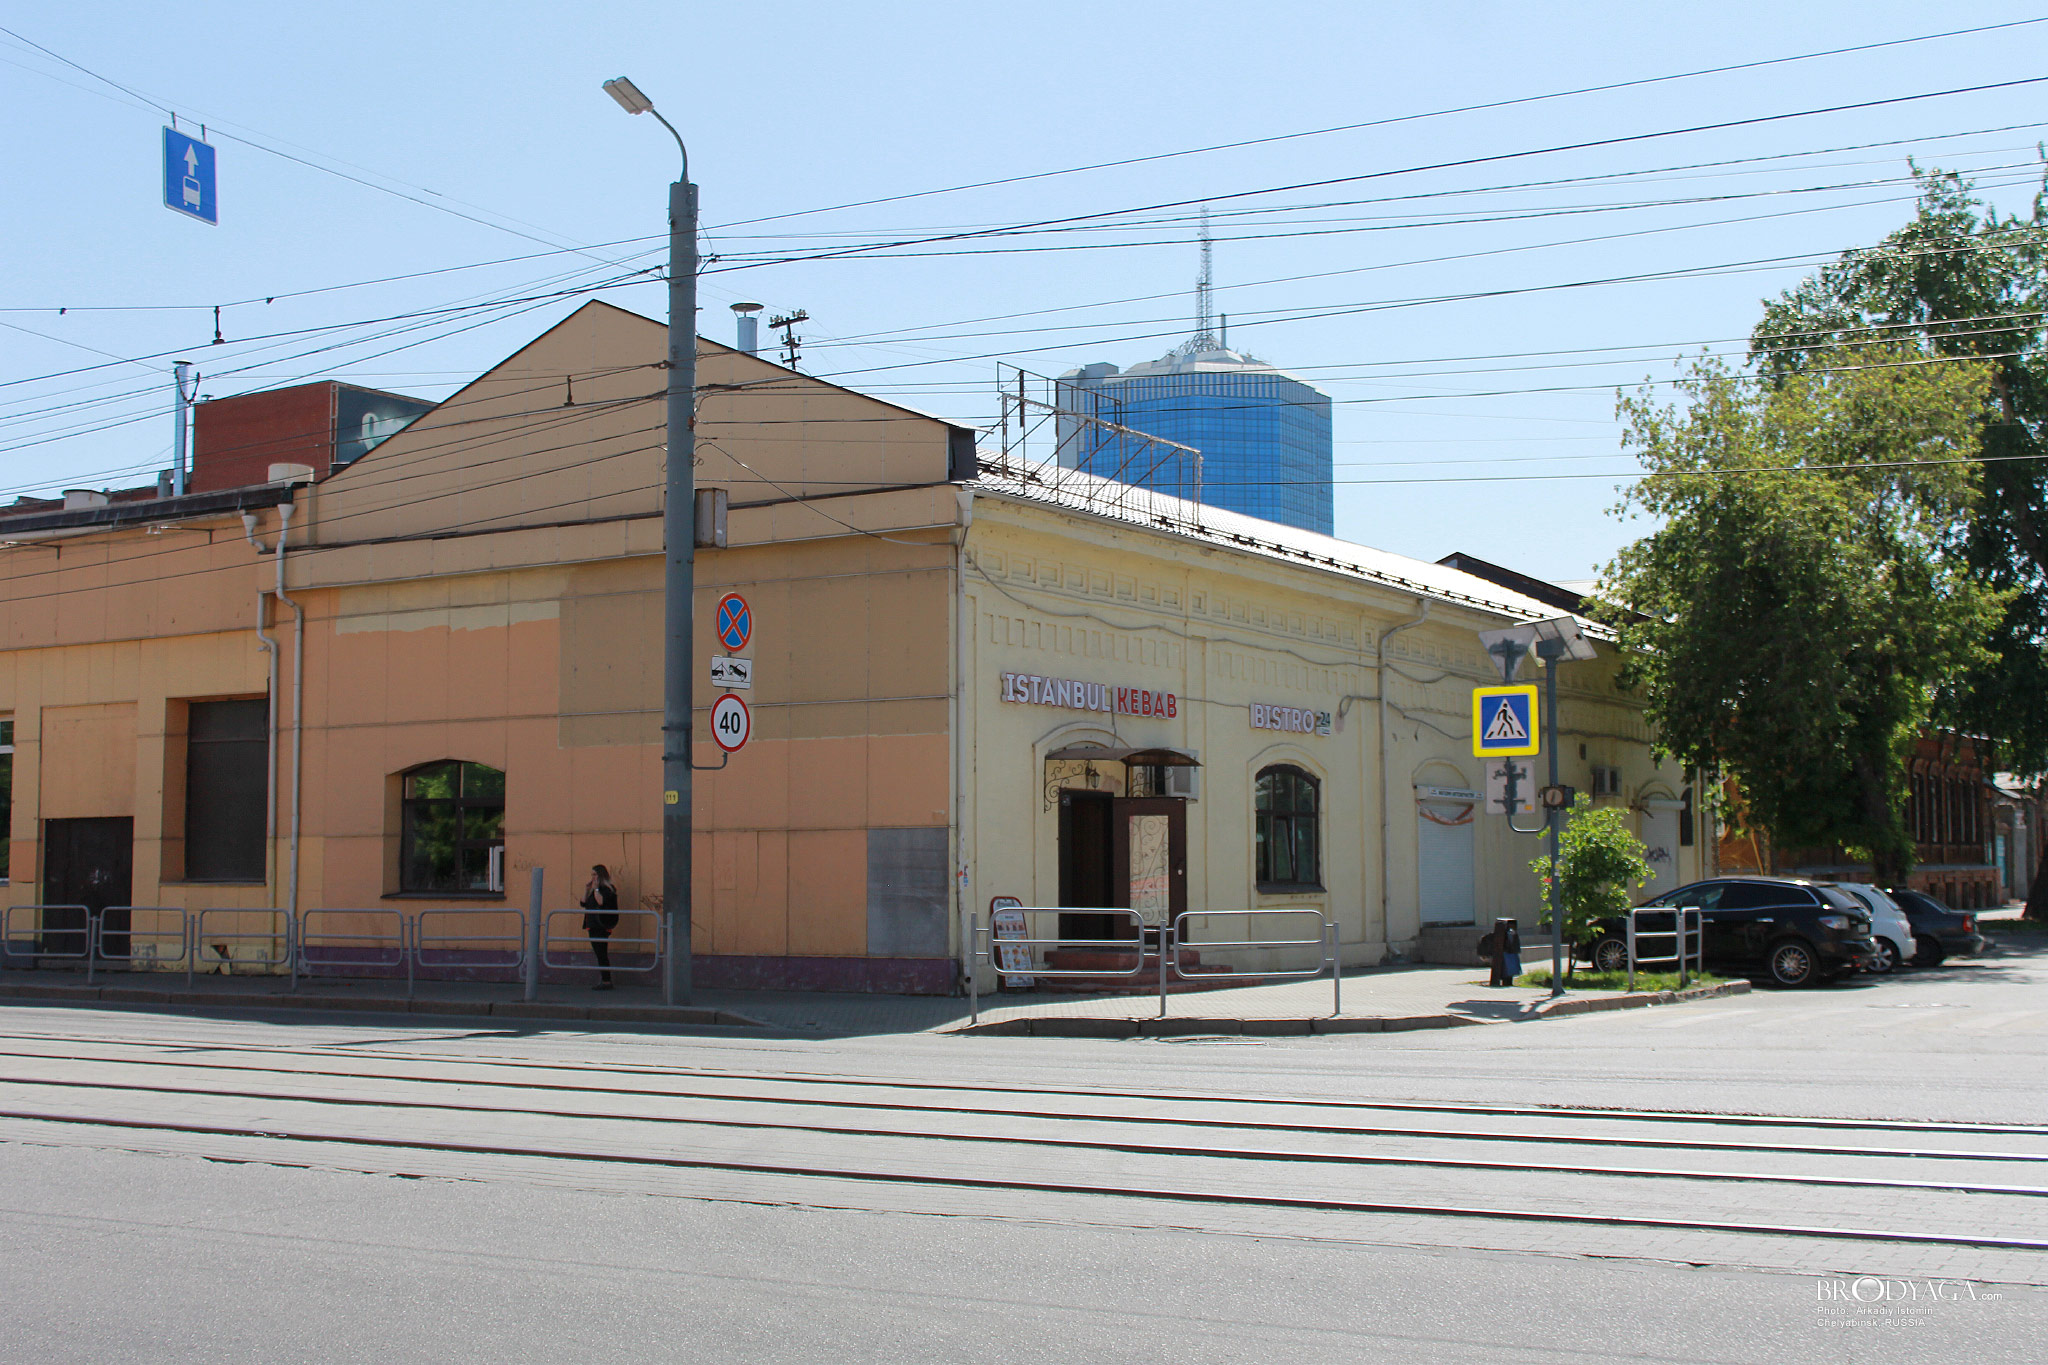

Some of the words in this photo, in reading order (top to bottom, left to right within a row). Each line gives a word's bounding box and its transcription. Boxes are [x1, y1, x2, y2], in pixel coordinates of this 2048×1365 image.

[1004, 673, 1111, 713] ISTANBUL
[1116, 686, 1178, 719] KEBAB
[719, 711, 740, 734] 40
[1254, 703, 1315, 734] BISTRO
